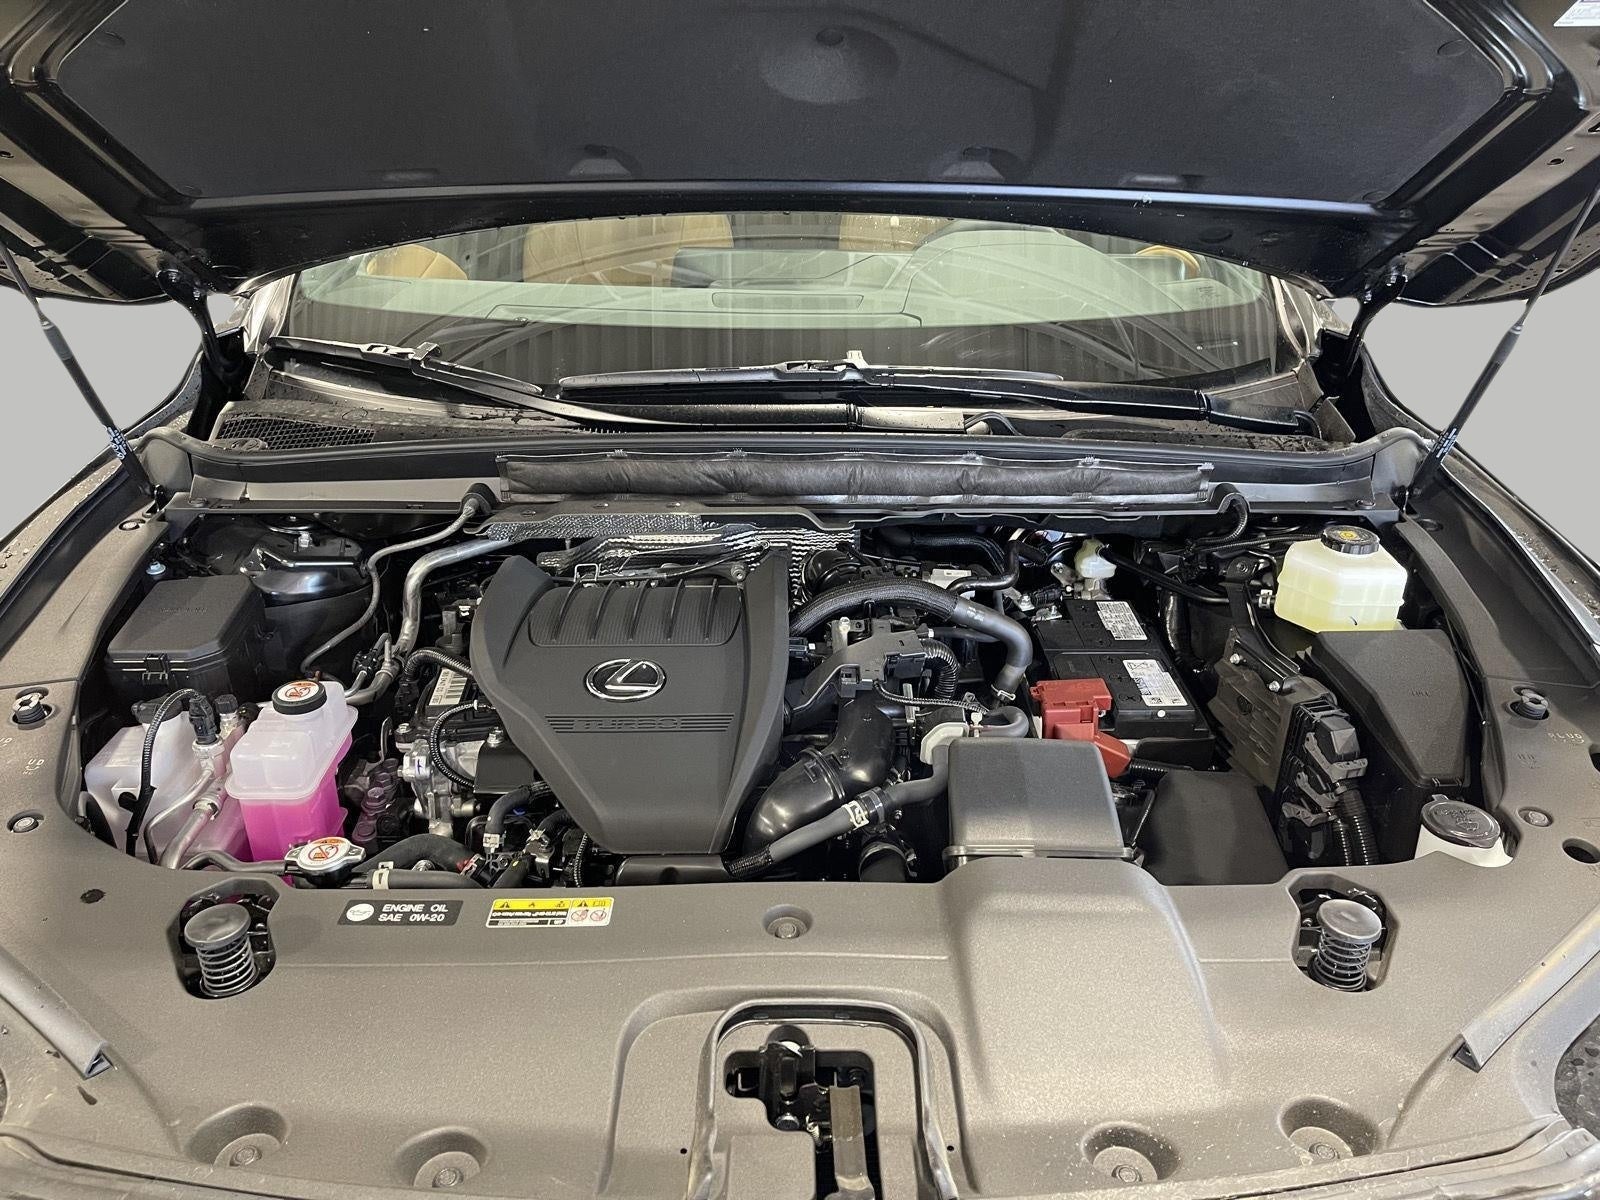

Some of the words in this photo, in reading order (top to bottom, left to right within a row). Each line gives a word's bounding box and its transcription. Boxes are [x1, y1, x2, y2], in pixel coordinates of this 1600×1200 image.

[576, 718, 680, 731] TURBO
[382, 903, 425, 913] ENGINE
[430, 903, 449, 913] OIL
[378, 913, 404, 922] SAE
[409, 913, 446, 922] 0W-20
